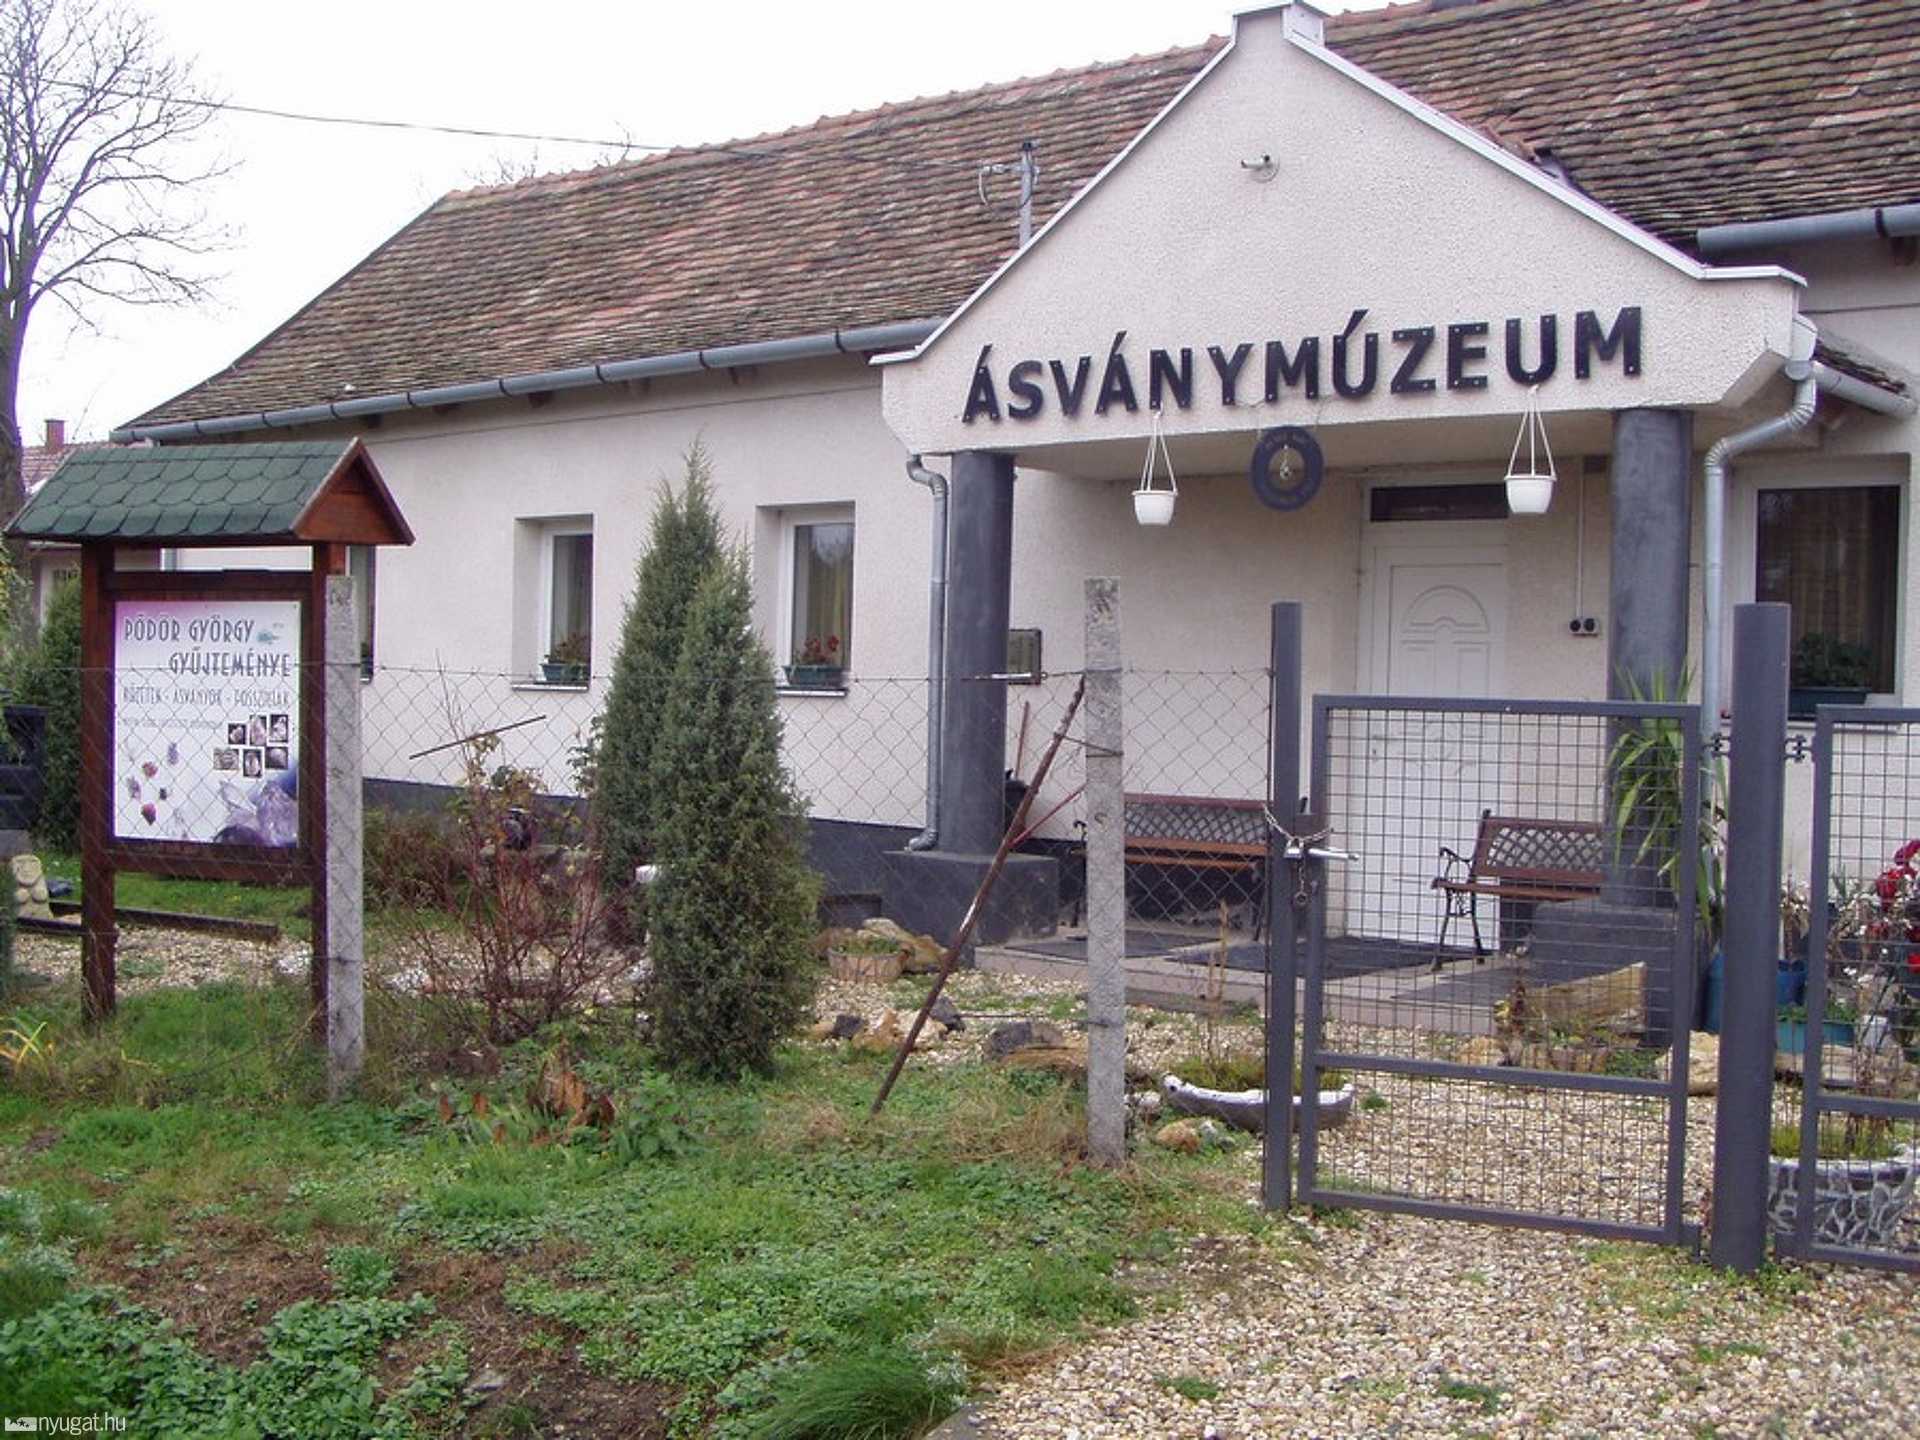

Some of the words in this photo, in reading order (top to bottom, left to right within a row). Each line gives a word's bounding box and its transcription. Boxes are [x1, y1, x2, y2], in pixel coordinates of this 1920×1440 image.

[962, 306, 1641, 424] ÁSVÁNYMÚZEUM
[189, 614, 255, 643] GYÖRGY
[169, 647, 291, 677] GYŰJTEMÉNYE
